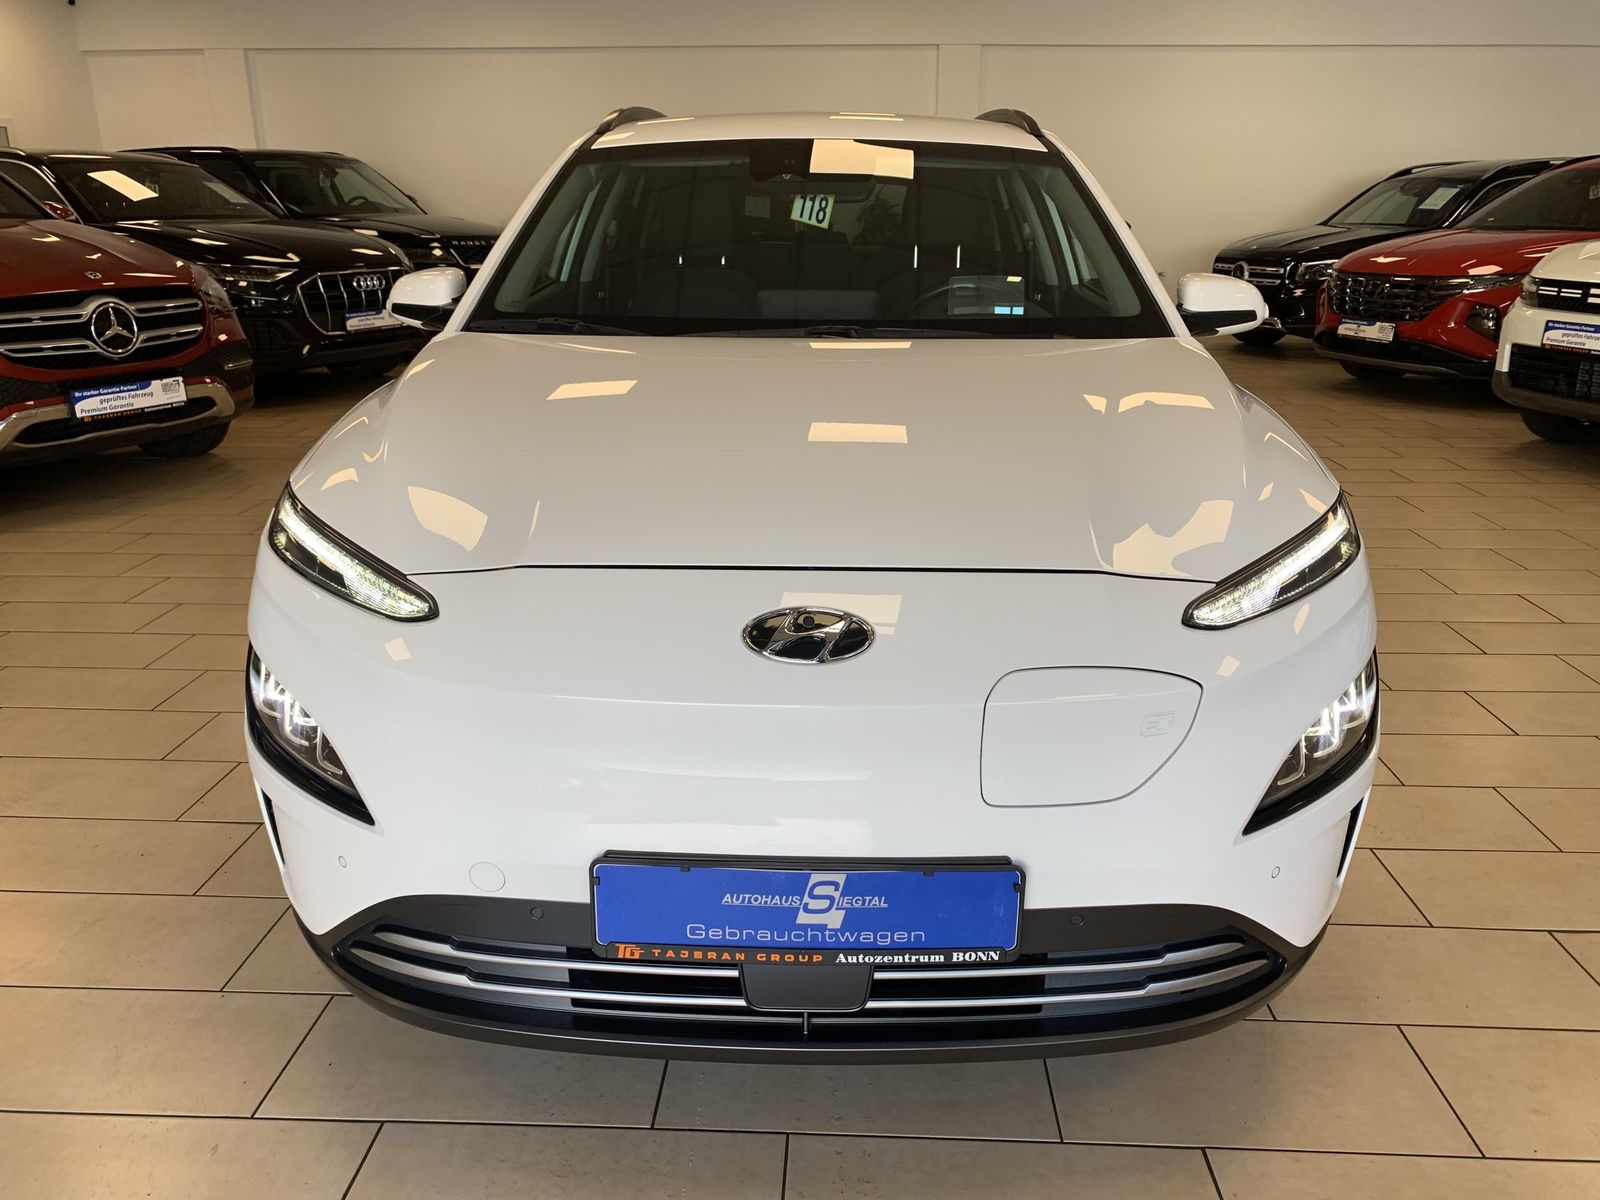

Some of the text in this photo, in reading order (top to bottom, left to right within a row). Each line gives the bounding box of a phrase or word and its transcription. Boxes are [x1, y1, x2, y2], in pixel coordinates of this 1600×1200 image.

[800, 194, 829, 225] 118
[99, 394, 128, 405] geprüftes
[128, 391, 154, 399] Fahrzeug
[80, 406, 108, 415] Premium
[108, 402, 135, 411] Garantie
[721, 893, 801, 907] AUTOHAUS
[686, 924, 926, 946] Gebrauchtwagen
[652, 949, 745, 961] TAJERAN
[756, 953, 823, 963] GROUP
[835, 951, 1000, 964] Autozentrum BONN
